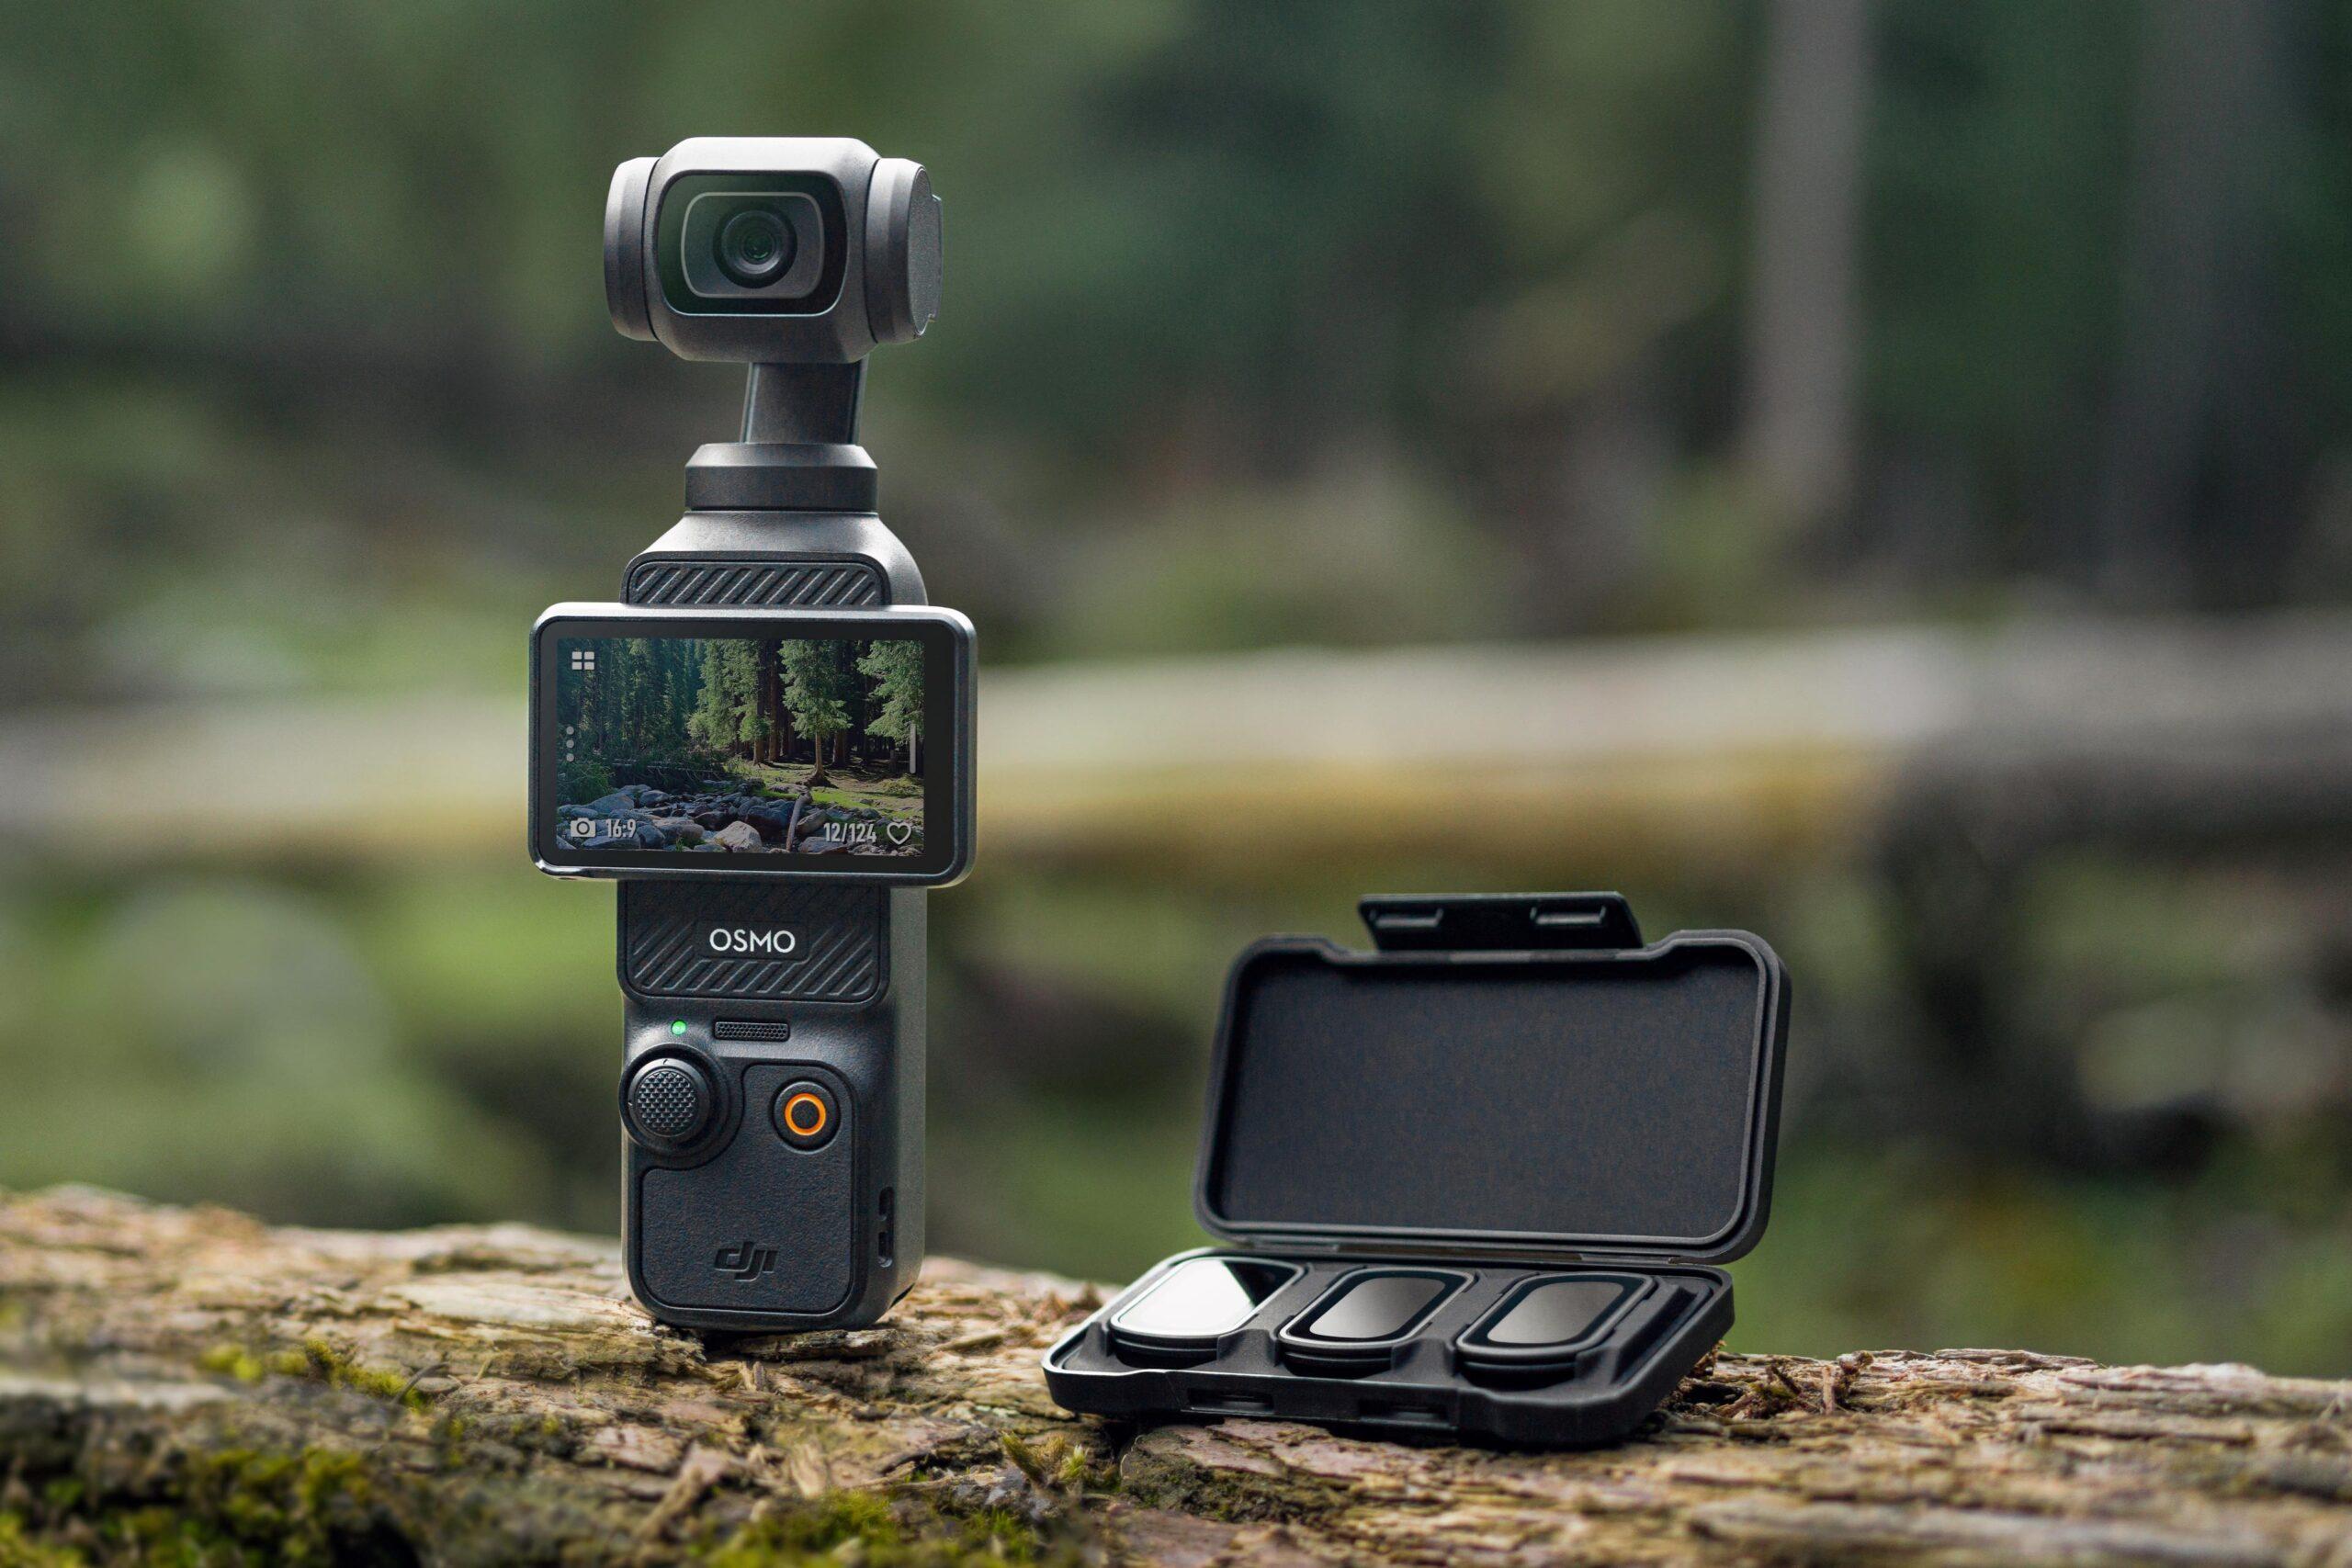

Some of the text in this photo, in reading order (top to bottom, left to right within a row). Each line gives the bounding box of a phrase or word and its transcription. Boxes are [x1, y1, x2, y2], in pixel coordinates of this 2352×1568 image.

[605, 818, 637, 838] 16:9
[824, 822, 876, 843] 12/124
[709, 928, 796, 953] OSMO
